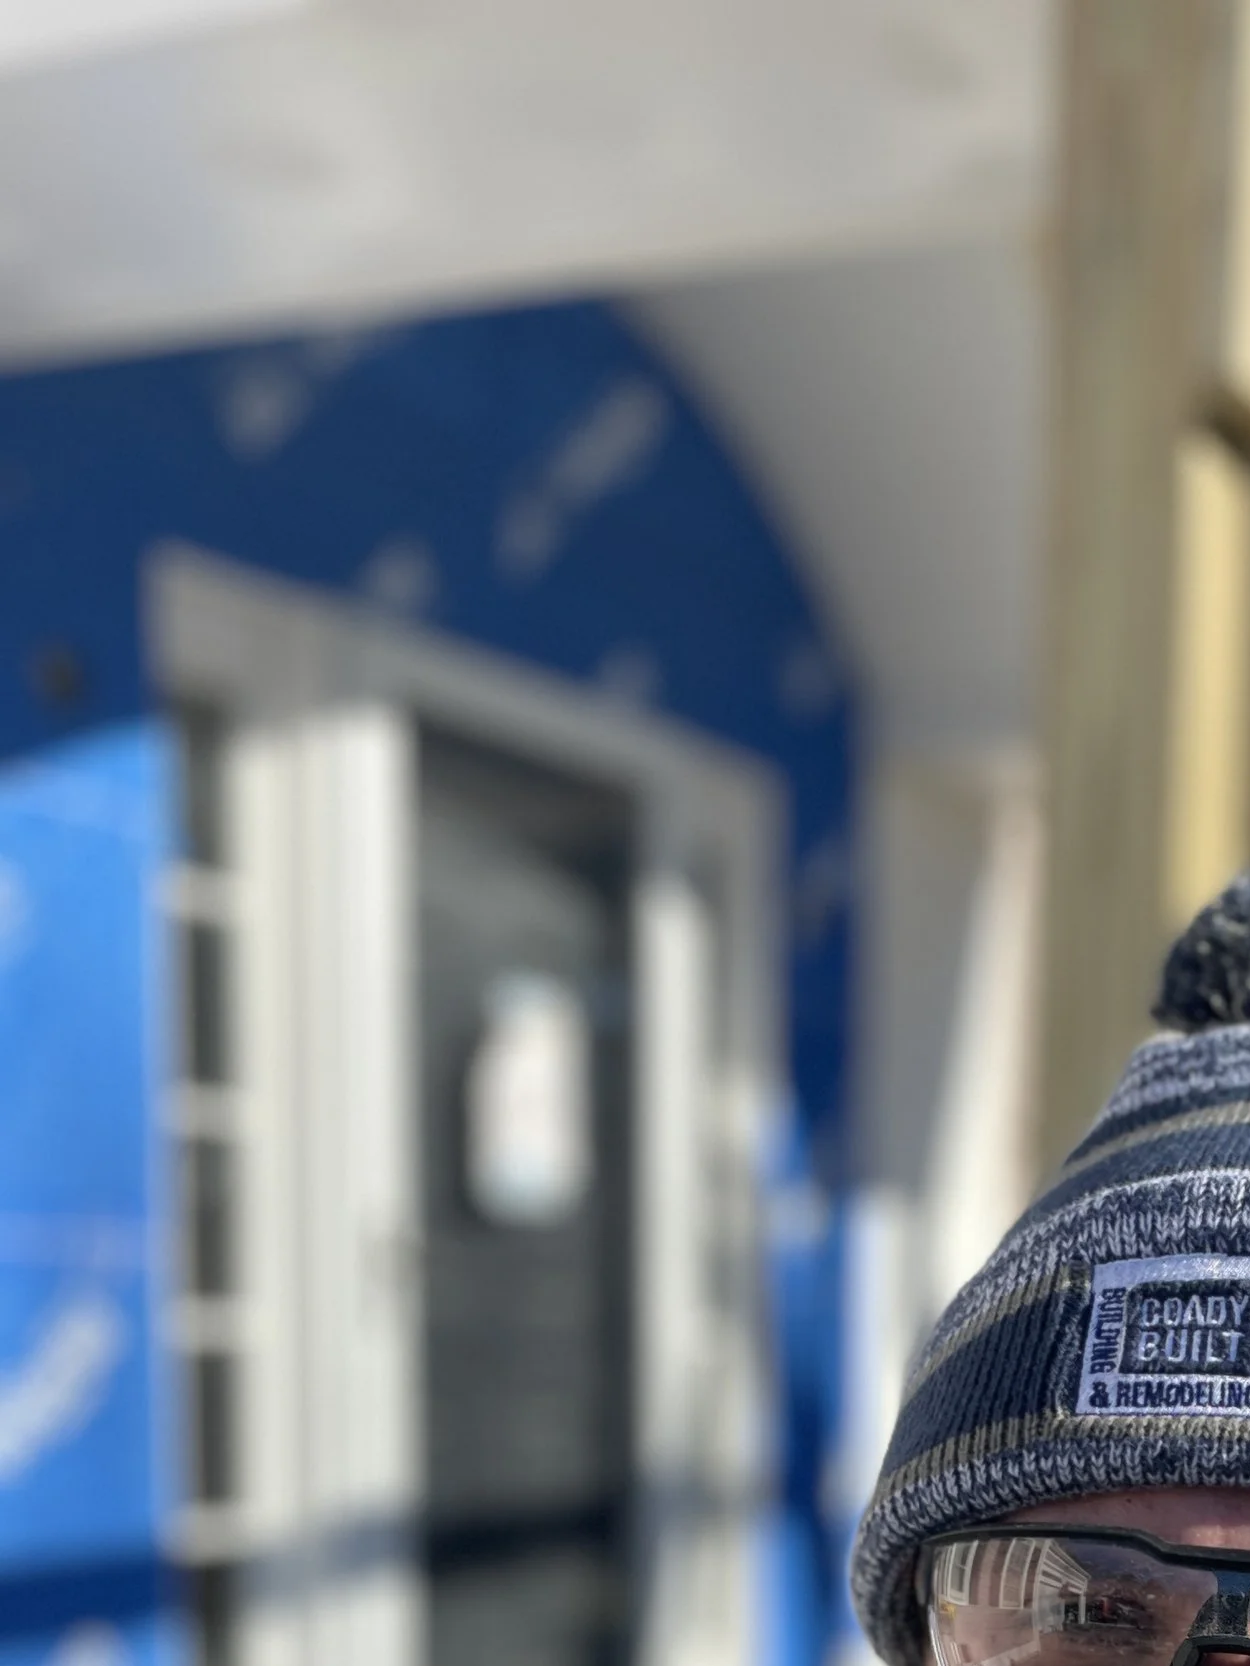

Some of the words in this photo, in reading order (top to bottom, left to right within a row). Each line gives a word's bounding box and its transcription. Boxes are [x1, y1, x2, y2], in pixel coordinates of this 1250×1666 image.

[1141, 1294, 1249, 1327] COADY
[1089, 1286, 1127, 1374] BUILDING
[1137, 1328, 1245, 1363] BUILT
[1088, 1381, 1112, 1409] &
